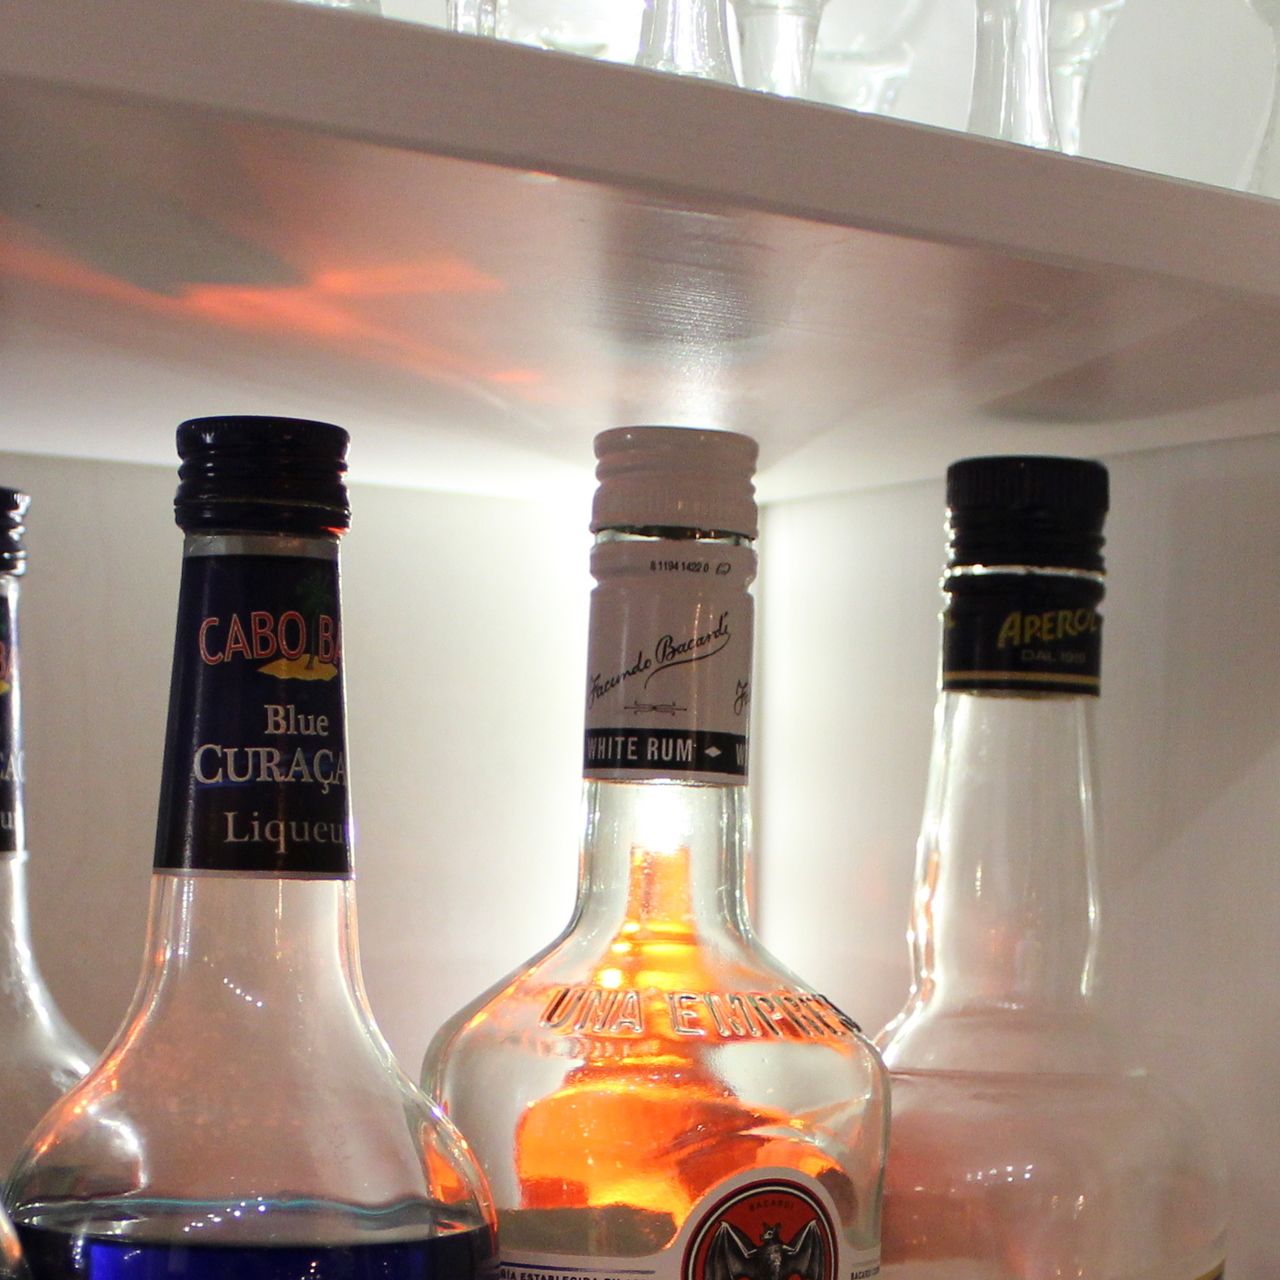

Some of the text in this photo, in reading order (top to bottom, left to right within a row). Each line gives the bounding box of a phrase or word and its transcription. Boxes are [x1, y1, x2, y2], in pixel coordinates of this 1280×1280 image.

[198, 610, 306, 666] CABO
[995, 608, 1098, 649] APEROL
[263, 704, 329, 736] Blue
[586, 737, 692, 762] WHITE RUM
[223, 810, 343, 854] Liqueu
[537, 986, 644, 1034] UNA
